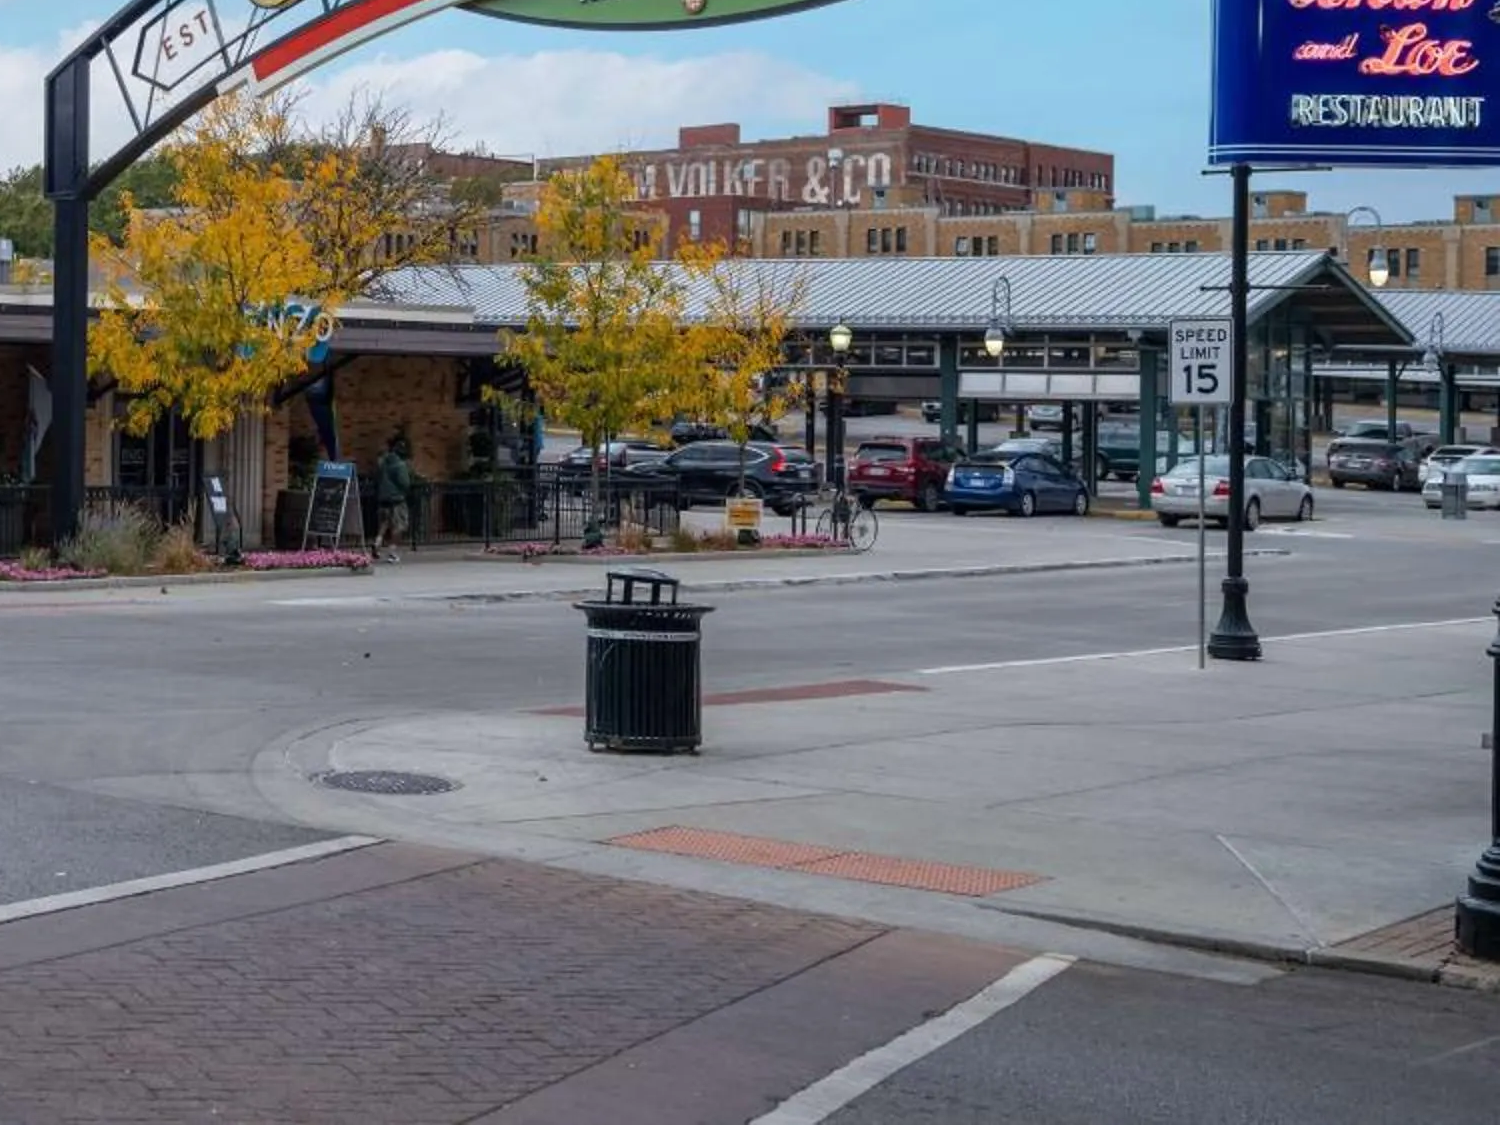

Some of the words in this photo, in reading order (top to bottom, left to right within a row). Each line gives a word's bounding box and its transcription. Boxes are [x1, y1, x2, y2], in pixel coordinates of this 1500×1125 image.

[161, 9, 210, 62] EST
[1292, 32, 1360, 61] and
[1290, 93, 1486, 128] RESTAURANT
[802, 155, 830, 204] &
[1174, 327, 1228, 343] SPEED
[1181, 346, 1221, 361] LIMIT
[1182, 363, 1219, 395] 15
